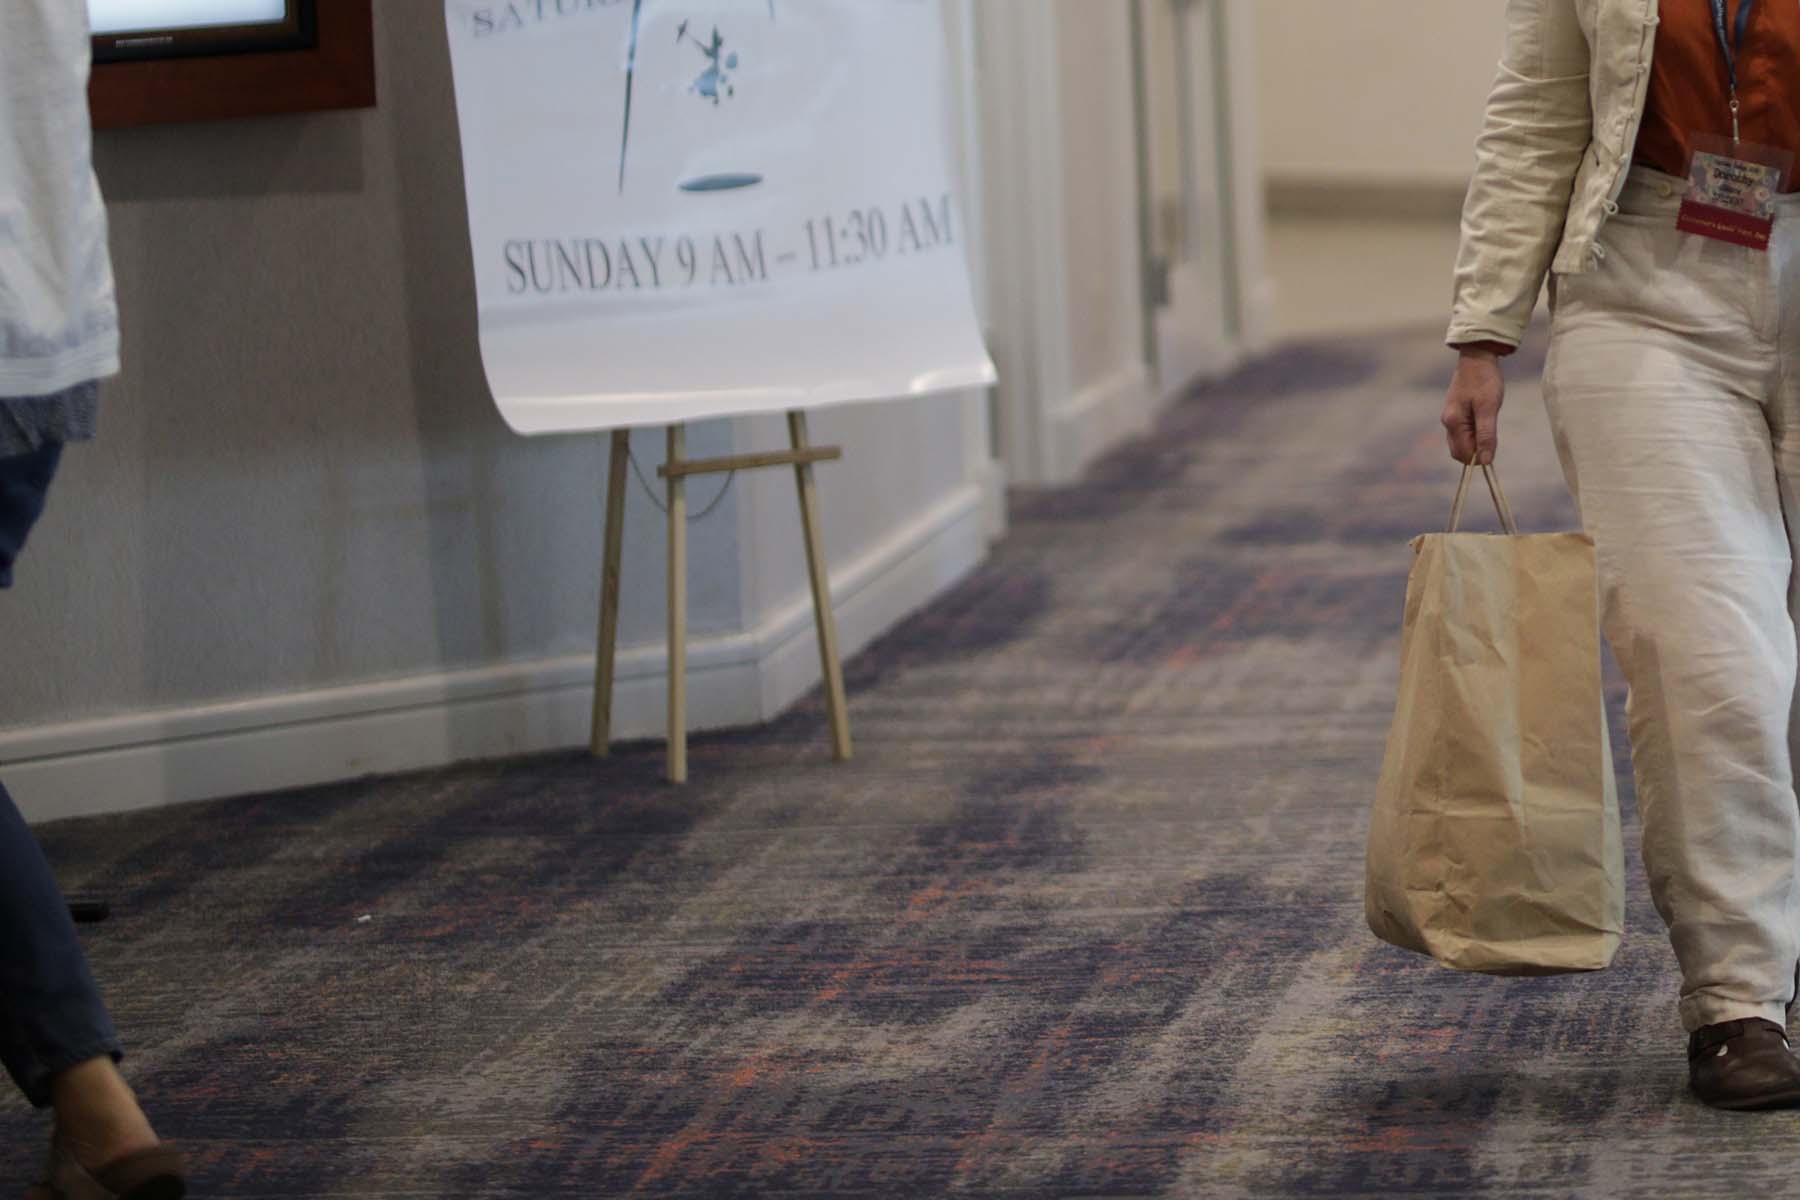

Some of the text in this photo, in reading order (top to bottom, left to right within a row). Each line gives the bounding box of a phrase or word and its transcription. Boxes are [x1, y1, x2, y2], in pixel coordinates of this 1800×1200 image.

[503, 237, 664, 295] SUNDAY
[675, 237, 697, 282] 9
[708, 229, 770, 287] AM
[803, 205, 889, 272] 11:30
[897, 192, 955, 253] AM
